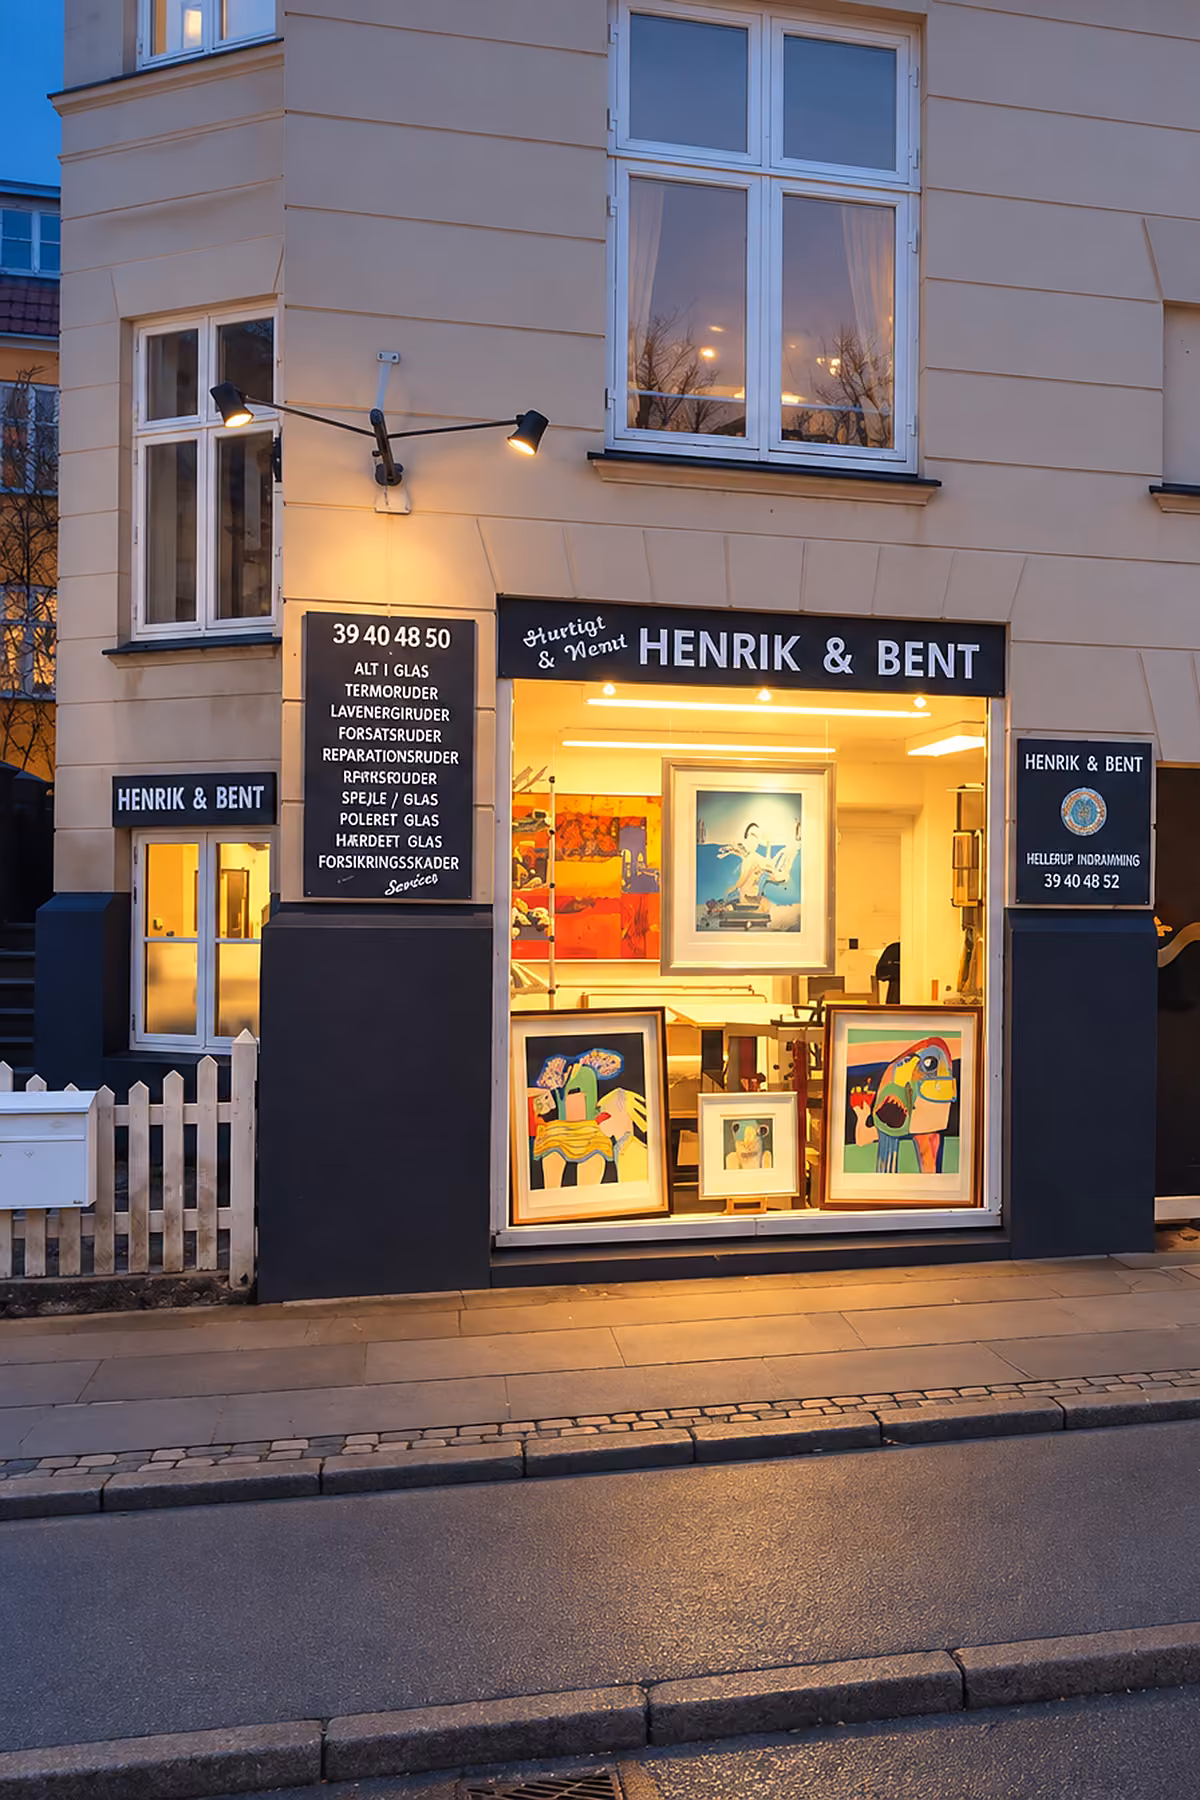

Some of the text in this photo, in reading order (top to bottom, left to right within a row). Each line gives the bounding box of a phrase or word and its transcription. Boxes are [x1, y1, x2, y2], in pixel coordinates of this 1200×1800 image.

[332, 623, 451, 649] 39 40 48 50
[522, 615, 607, 648] Hurtigt
[538, 650, 555, 669] &
[639, 627, 980, 680] HENRIK & BENT
[354, 661, 429, 678] ALT I GLAS
[345, 683, 439, 701] TERMORUDER
[330, 704, 450, 722] LAVENERGIRUDER
[338, 726, 442, 743] FORSATSRUDER
[322, 748, 459, 765] REPARATIONSRUDER
[1025, 753, 1144, 773] HENRIK & BENT
[118, 785, 265, 811] HENRIK & BENT
[341, 791, 387, 807] SPEJLE
[403, 793, 439, 806] GLAS
[340, 812, 440, 827] POLERET GLAS
[407, 835, 443, 849] GLAS
[318, 854, 459, 870] FORSIKRINGSSKADER
[1026, 852, 1074, 866] HELLERUP
[1044, 873, 1120, 889] 39 40 48 52
